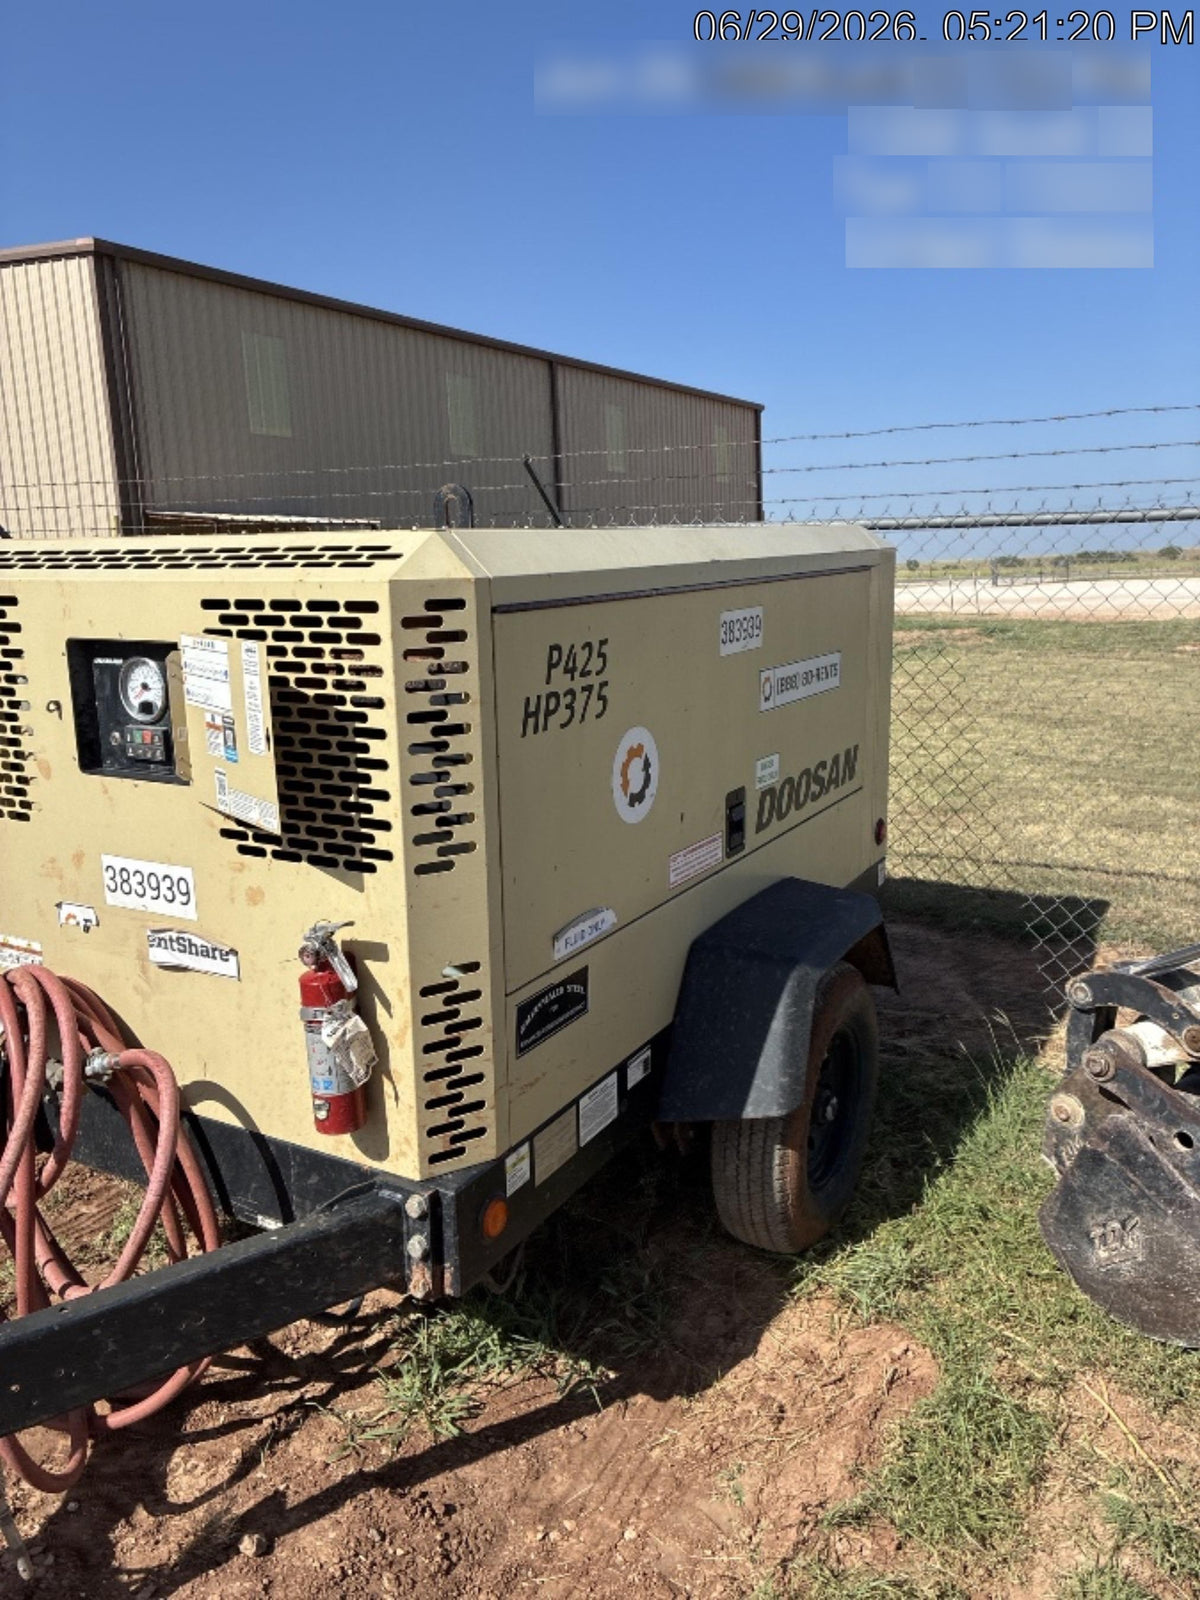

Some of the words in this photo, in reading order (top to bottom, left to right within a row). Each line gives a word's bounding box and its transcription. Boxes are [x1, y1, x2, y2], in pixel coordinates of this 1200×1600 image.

[721, 614, 762, 645] 383939
[545, 638, 608, 685] P425
[520, 680, 608, 738] HP375
[755, 744, 859, 834] DOOSAN
[104, 865, 191, 906] 383939
